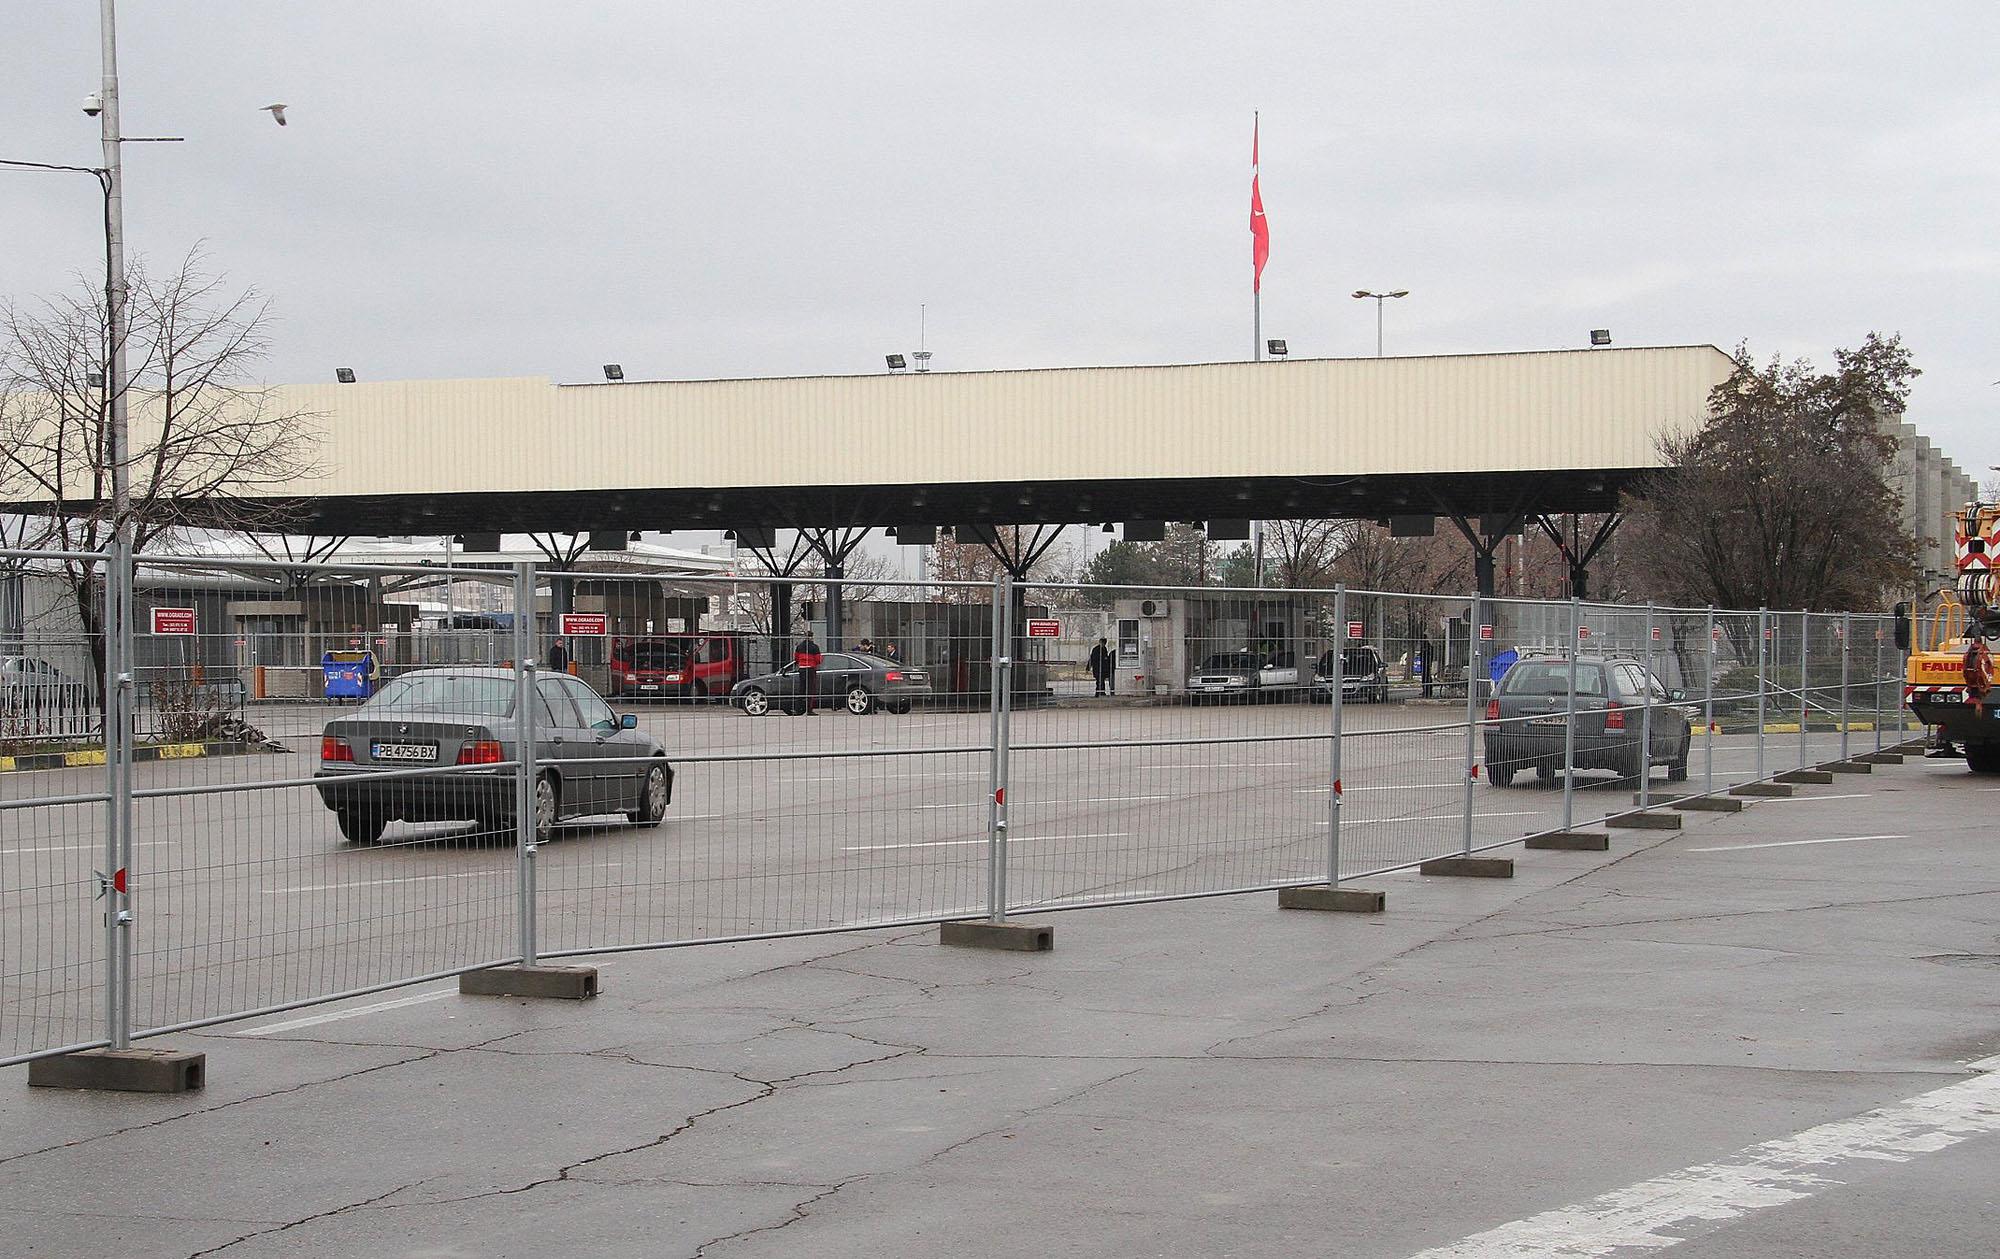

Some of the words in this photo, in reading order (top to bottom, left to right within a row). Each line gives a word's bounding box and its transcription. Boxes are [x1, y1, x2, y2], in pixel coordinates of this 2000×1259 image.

[379, 745, 392, 757] PB
[394, 746, 419, 758] 4756
[420, 747, 435, 759] BX
